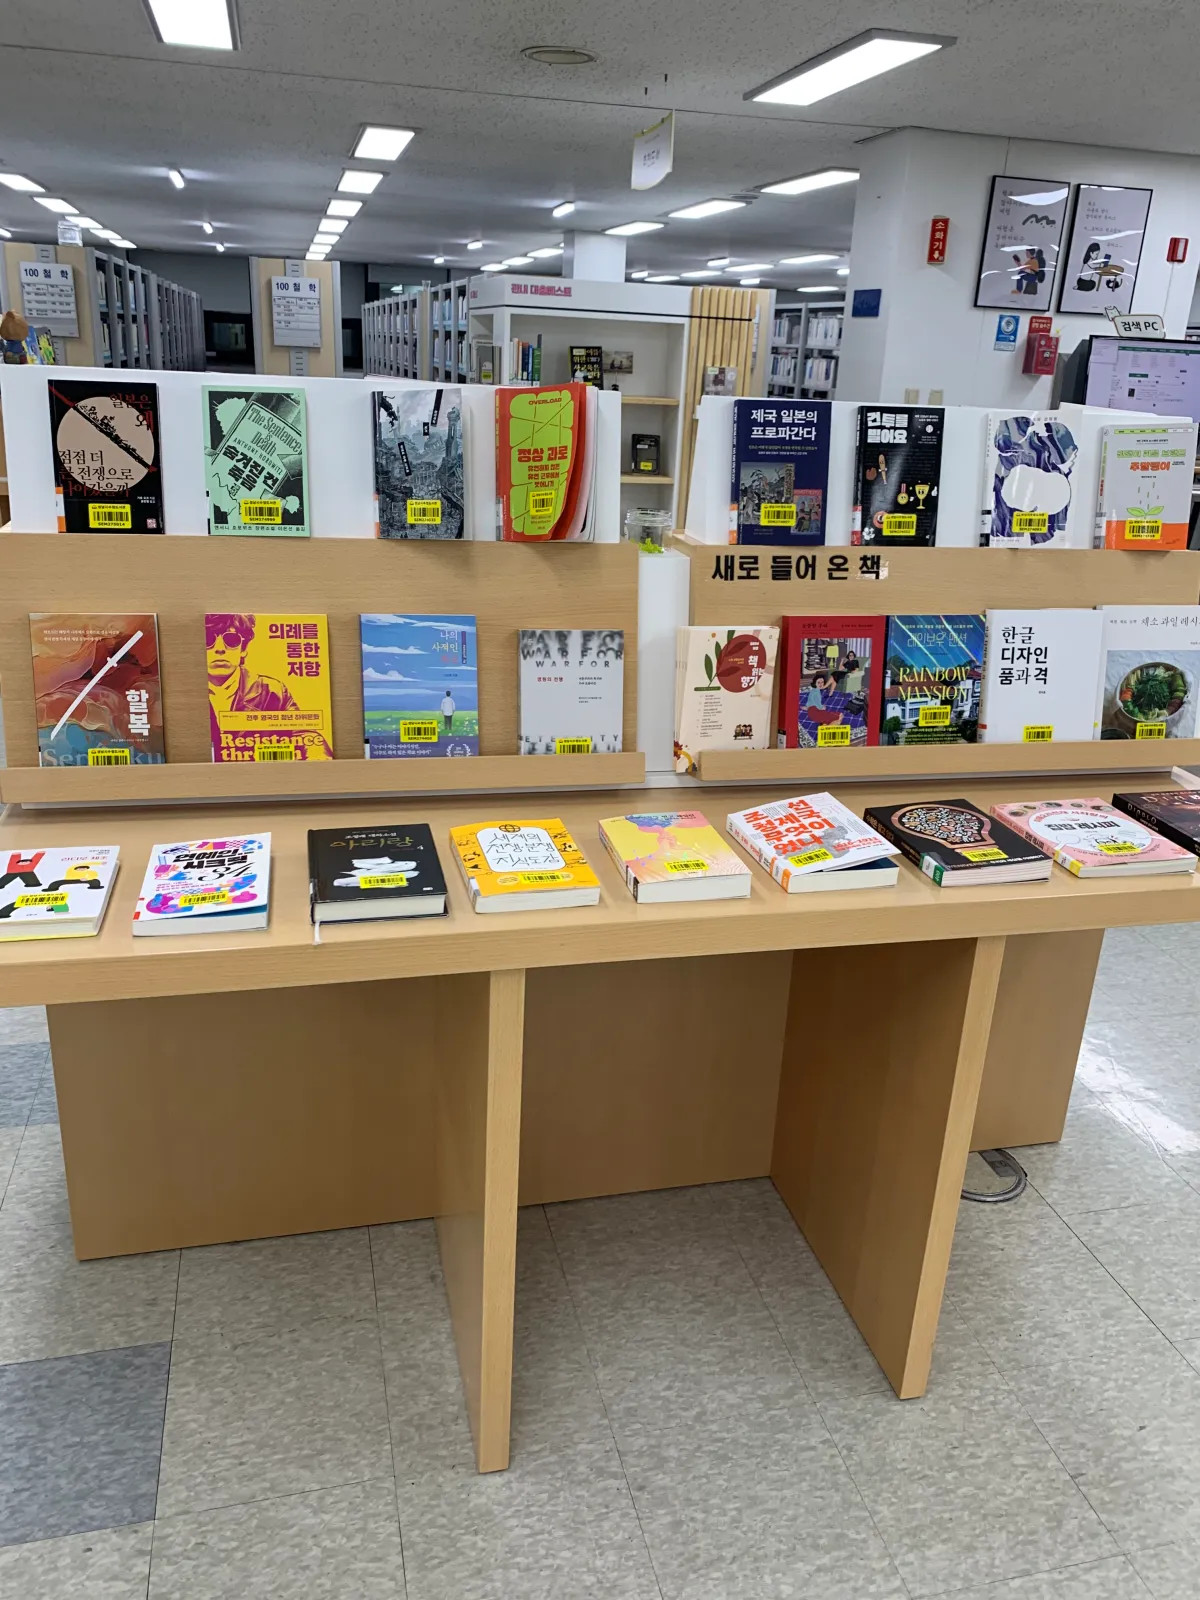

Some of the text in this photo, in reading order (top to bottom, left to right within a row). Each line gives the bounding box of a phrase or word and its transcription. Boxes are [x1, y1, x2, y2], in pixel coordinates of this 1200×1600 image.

[933, 222, 946, 249] 소화기
[24, 268, 39, 277] 100
[276, 282, 289, 290] 100
[511, 284, 572, 297] 관내 대출베스트
[1121, 321, 1158, 332] 검색 PC
[135, 410, 154, 433] 왜
[247, 407, 263, 426] The
[751, 409, 818, 423] 제국 일본의
[867, 412, 908, 428] 건투를
[751, 426, 816, 440] 프로파간다
[867, 429, 908, 444] 빌어요
[251, 431, 276, 457] Death
[59, 450, 104, 465] 점점 더
[233, 437, 283, 476] ANTHONY HOROWITZ
[547, 446, 568, 461] 과로
[77, 466, 134, 482] 전쟁으로
[222, 444, 280, 490] 숨겨진 건
[227, 464, 258, 492] 죽음
[712, 555, 881, 581] 새로 들어 온 책
[1140, 616, 1159, 627] 채소
[1160, 616, 1178, 627] 과일
[269, 623, 319, 640] 의례를
[440, 630, 458, 640] 나의
[1001, 626, 1035, 644] 한글
[287, 642, 319, 659] 통한
[1001, 647, 1048, 664] 디자인
[748, 655, 758, 667] 책
[288, 661, 321, 677] 저항
[899, 667, 970, 682] RAINBOW
[998, 667, 1048, 685] 품과 격
[898, 685, 967, 700] MANSION
[126, 690, 150, 736] 할복
[220, 733, 324, 747] Resistance
[1127, 803, 1157, 824] DIABLO
[1044, 820, 1120, 831] 집밥 레시피
[330, 837, 414, 850] 아리랑
[489, 832, 542, 844] 세계의
[492, 853, 560, 867] 지식도감
